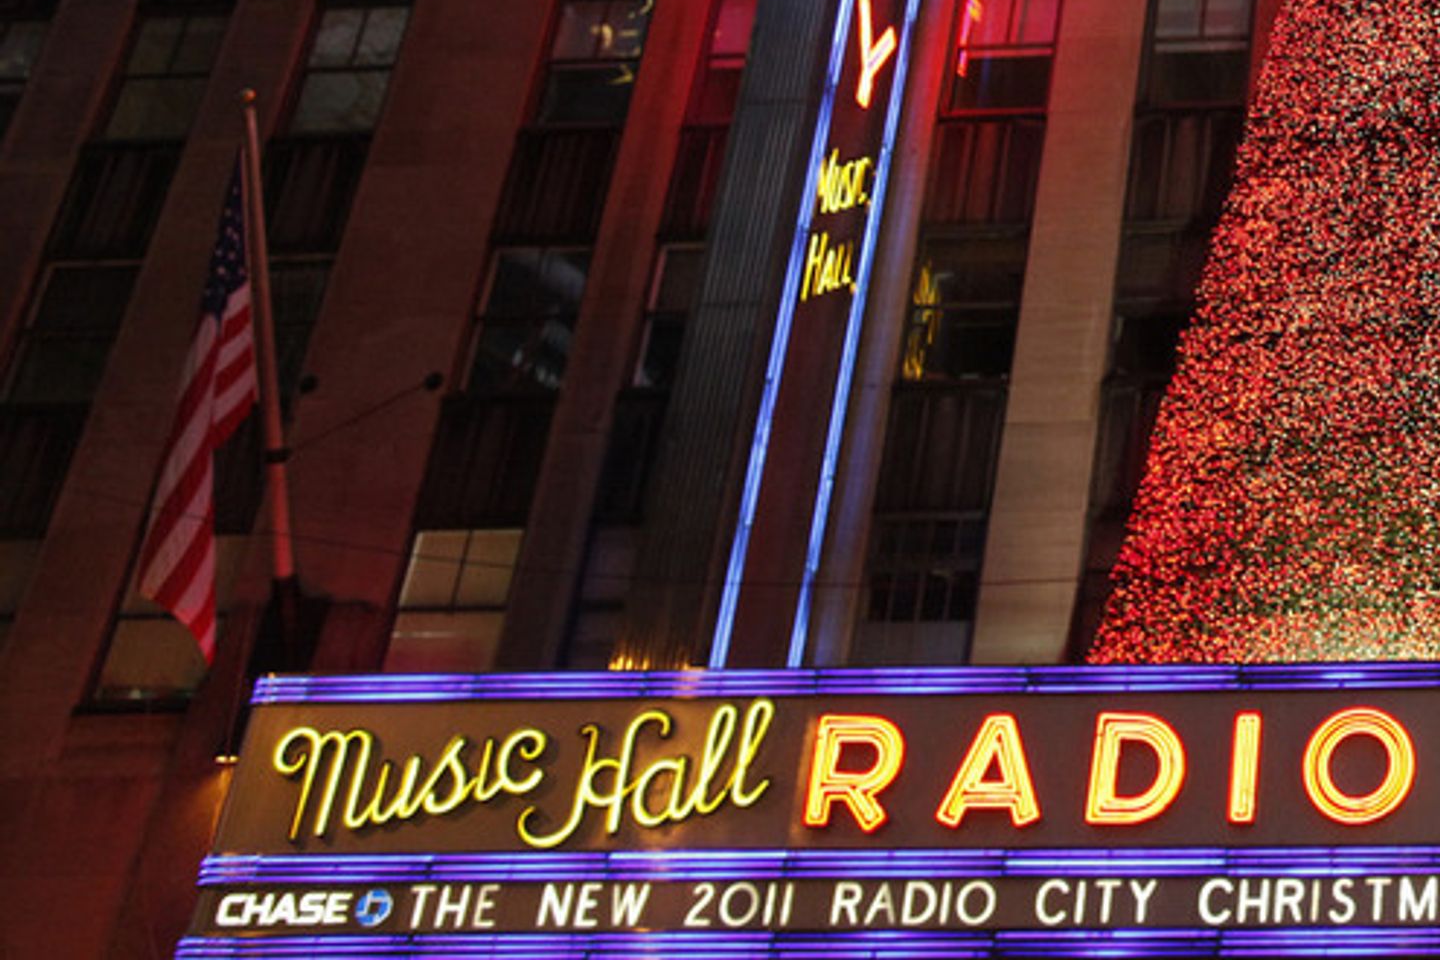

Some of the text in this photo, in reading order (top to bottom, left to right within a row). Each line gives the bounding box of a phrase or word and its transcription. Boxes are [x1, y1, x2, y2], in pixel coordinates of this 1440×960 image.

[801, 231, 852, 302] HALL
[271, 697, 776, 848] Music Hall
[802, 703, 1416, 831] RADIO
[215, 891, 350, 927] CHASE
[409, 884, 500, 929] THE
[536, 882, 652, 929] NEW
[682, 881, 795, 928] 2011
[829, 879, 998, 927] RADIO
[1034, 877, 1158, 925] CITY
